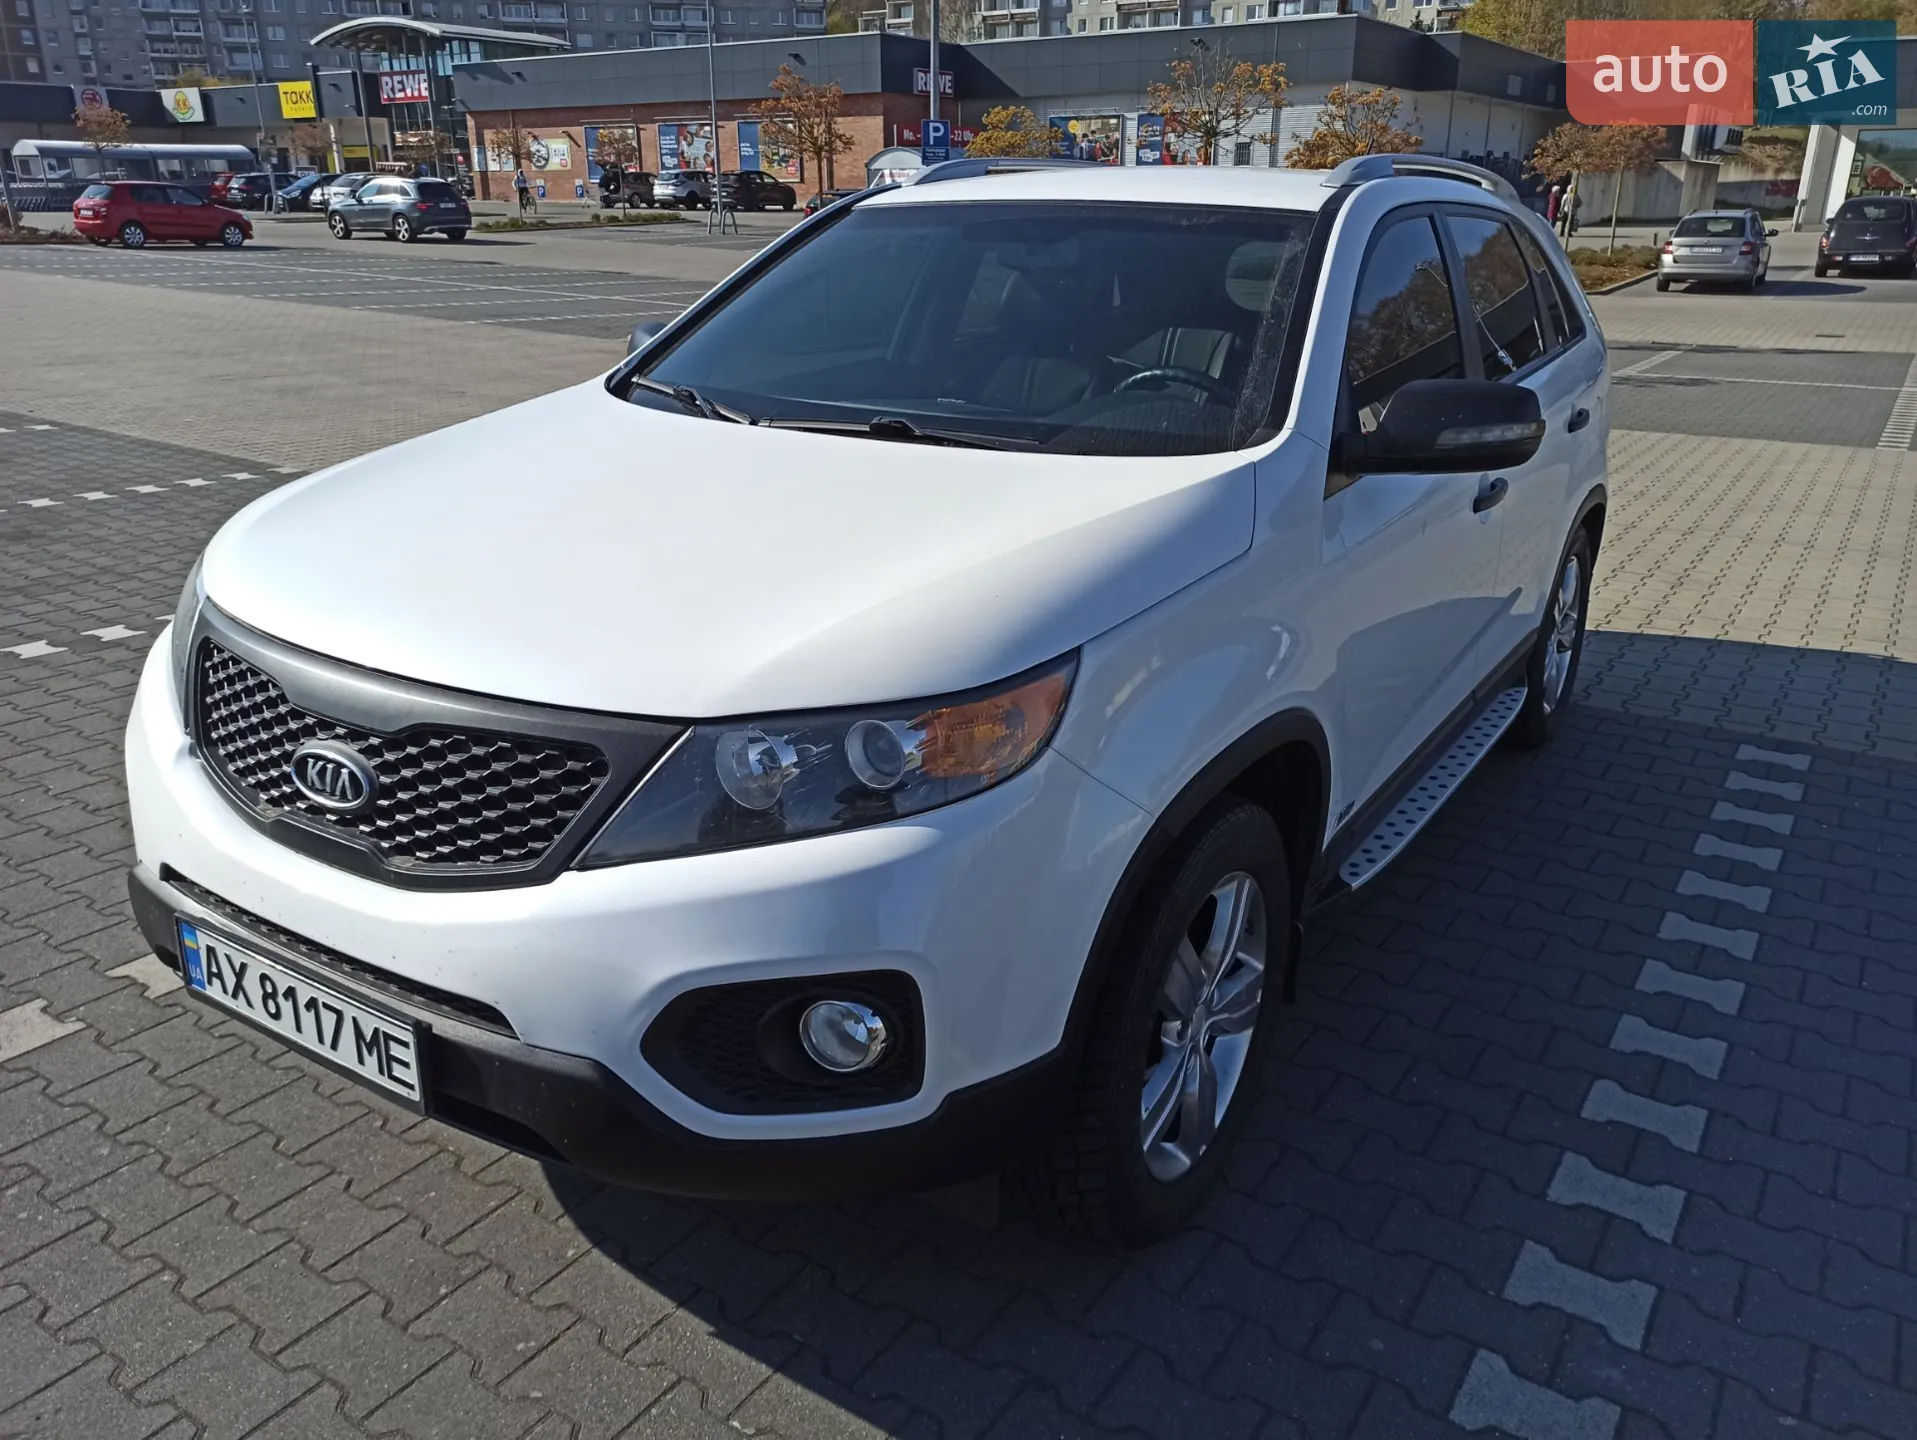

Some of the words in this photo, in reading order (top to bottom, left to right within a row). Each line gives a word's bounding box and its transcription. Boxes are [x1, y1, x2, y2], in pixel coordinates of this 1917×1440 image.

[381, 74, 429, 99] REWE
[929, 122, 945, 145] P
[538, 187, 544, 197] P
[577, 187, 583, 197] P
[307, 758, 353, 800] KIA
[188, 964, 204, 981] UA
[205, 944, 255, 1010] AX
[259, 972, 345, 1052] 8117
[351, 1014, 415, 1092] ME
